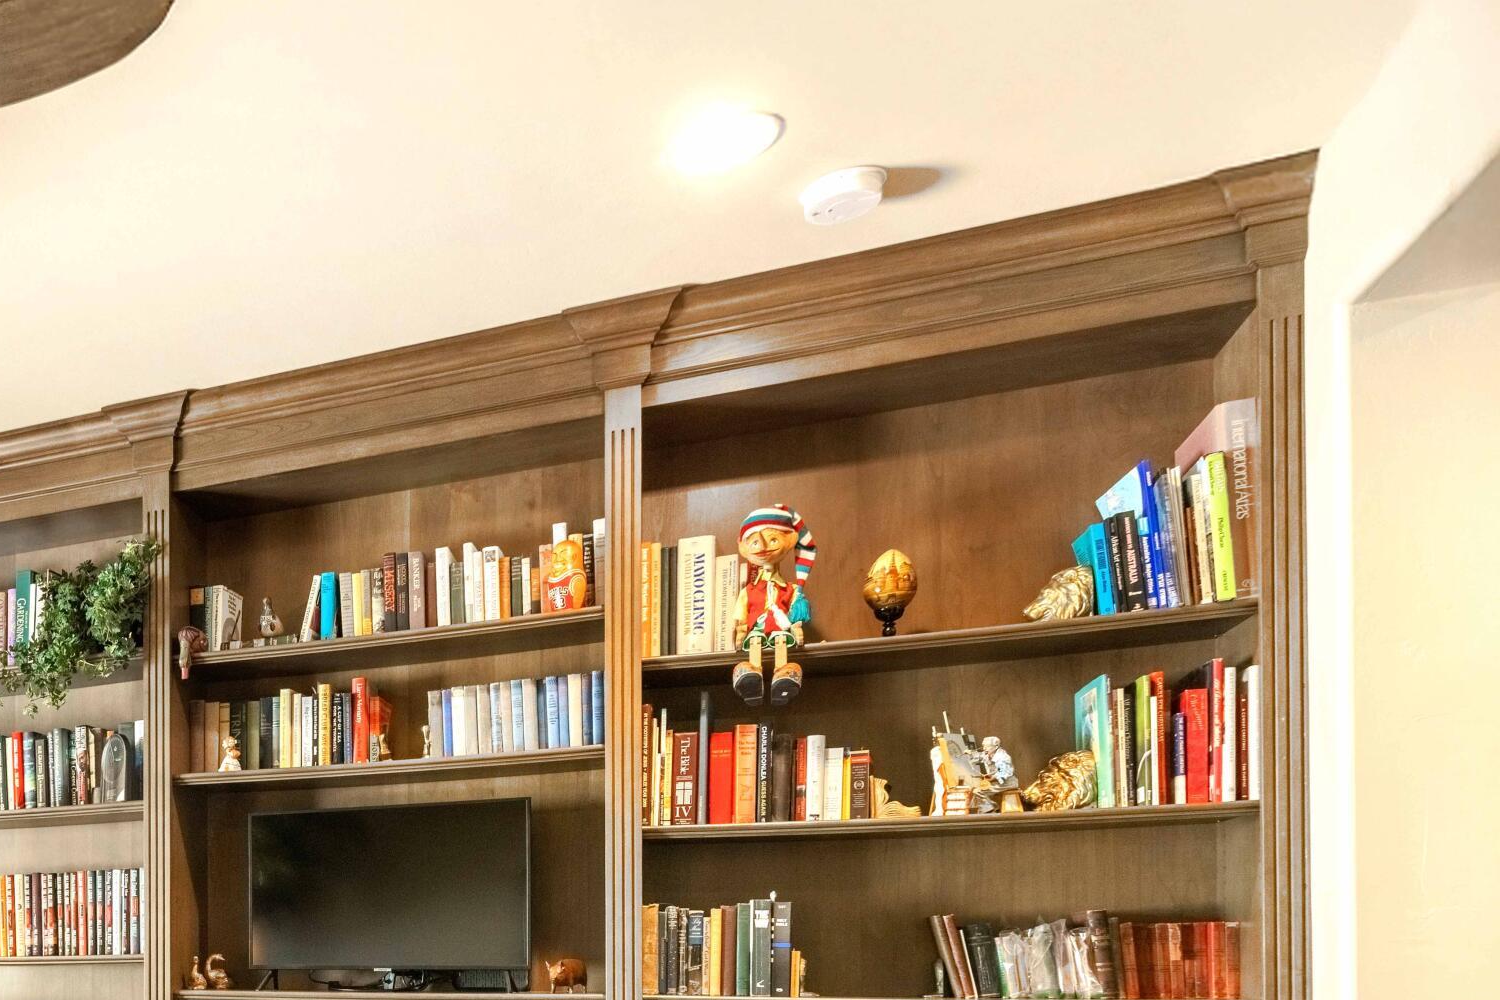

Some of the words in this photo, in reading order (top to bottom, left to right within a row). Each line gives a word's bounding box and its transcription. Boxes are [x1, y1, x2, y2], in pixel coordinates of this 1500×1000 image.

[1231, 419, 1254, 490] International
[1235, 492, 1255, 519] Atlas
[684, 553, 692, 580] FAMILY
[693, 553, 705, 588] MAYO
[1113, 554, 1121, 563] Art
[1127, 549, 1138, 584] AUSTRALIA
[412, 558, 421, 590] BANKER
[384, 570, 395, 612] MISERY
[684, 581, 692, 610] HEALTH
[16, 598, 27, 642] GARDENING
[684, 612, 692, 636] BOOK
[693, 590, 705, 635] CLINIC
[680, 737, 691, 755] The
[680, 756, 691, 775] Bible
[675, 806, 692, 817] IV
